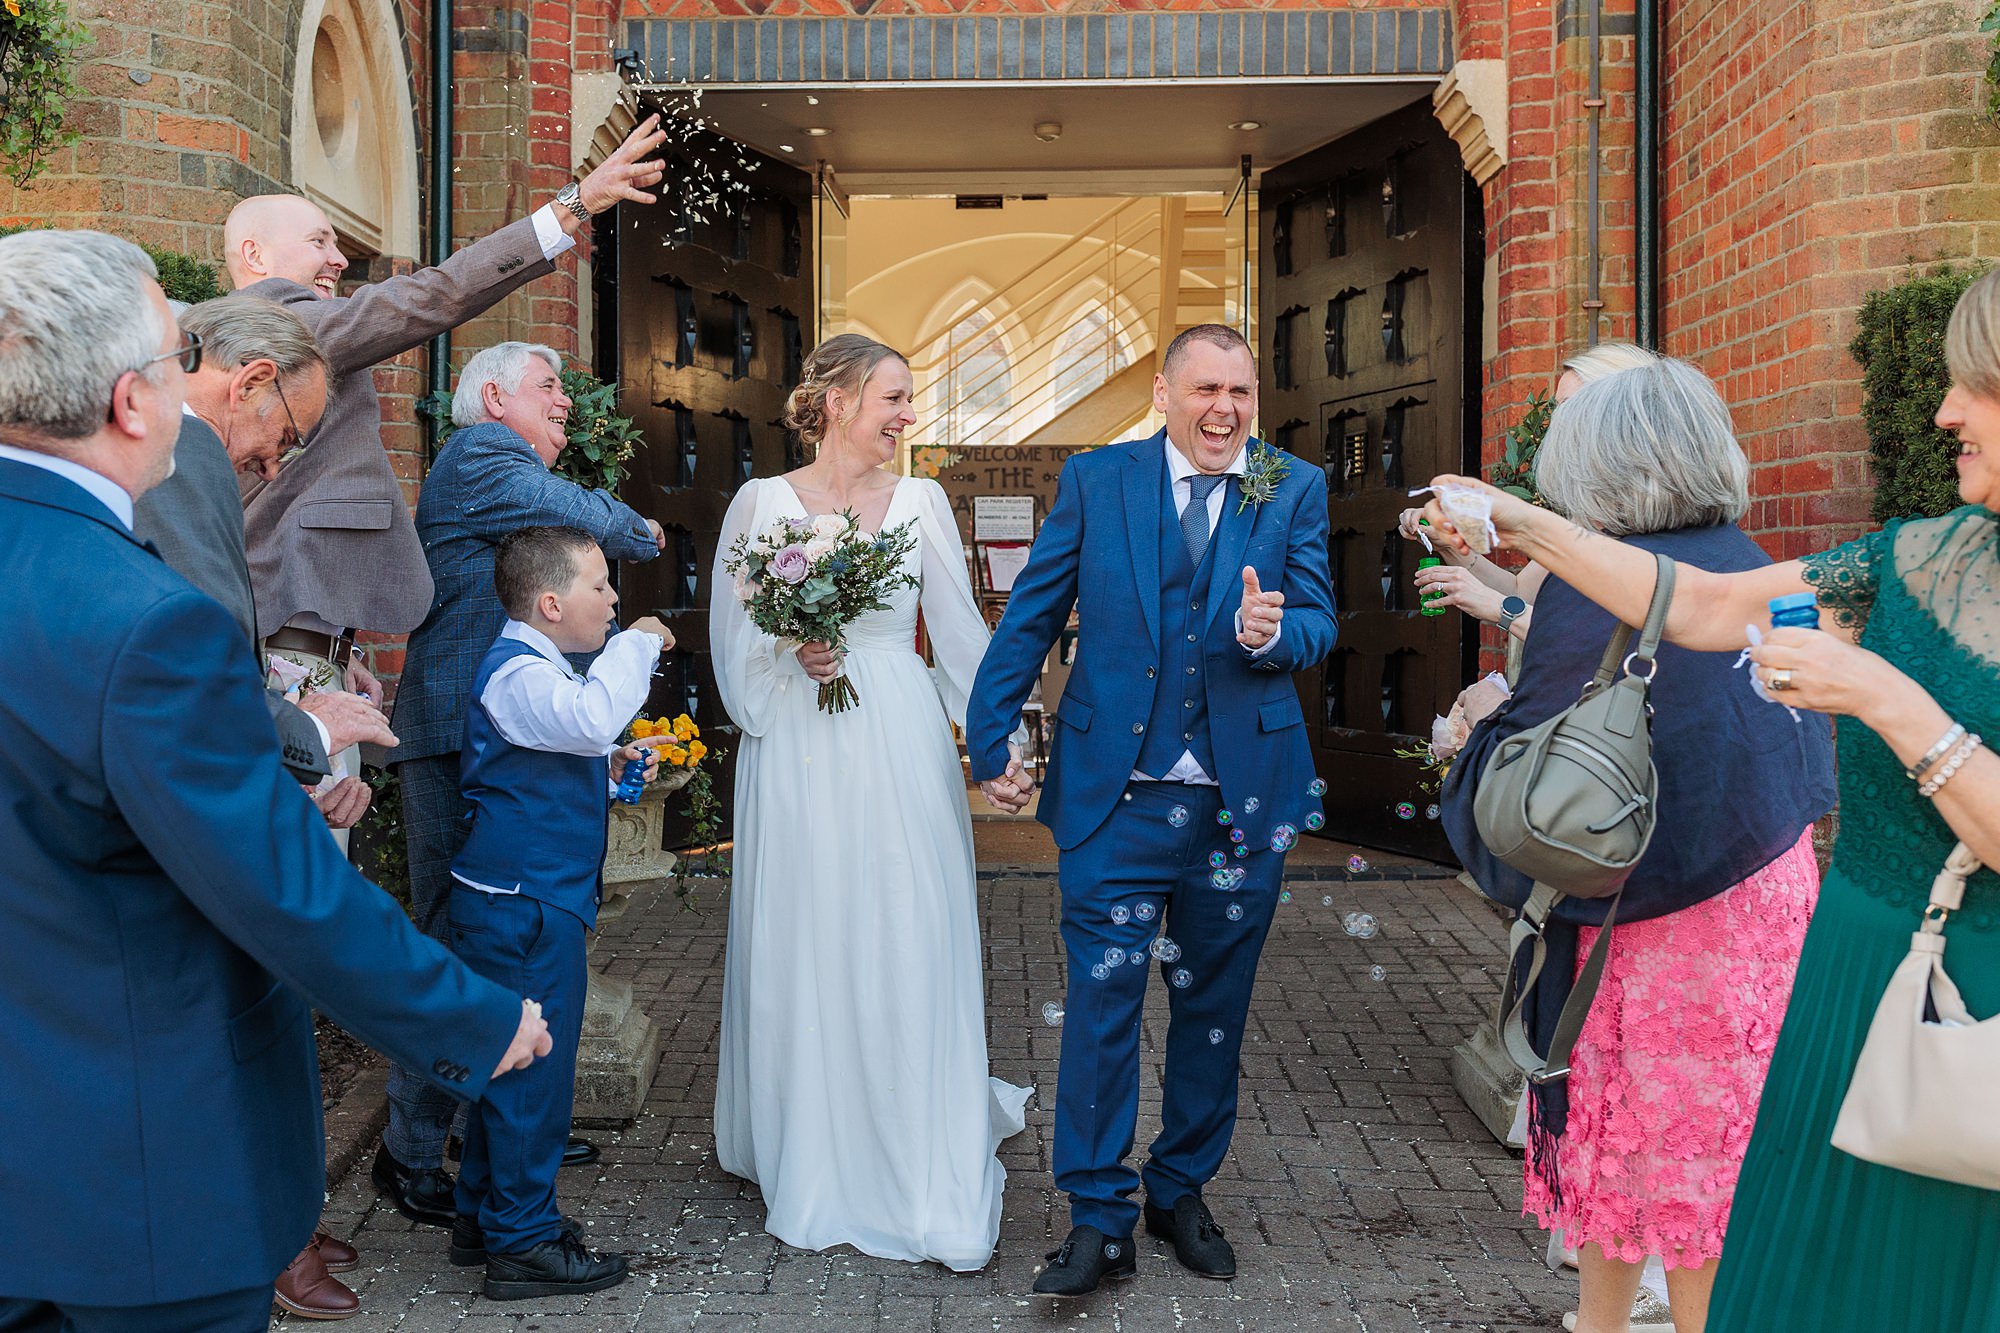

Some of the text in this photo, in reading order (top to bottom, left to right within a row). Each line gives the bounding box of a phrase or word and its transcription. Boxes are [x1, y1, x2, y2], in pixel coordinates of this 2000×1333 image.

[958, 447, 1071, 462] WELCOME TO
[984, 467, 1036, 489] THE
